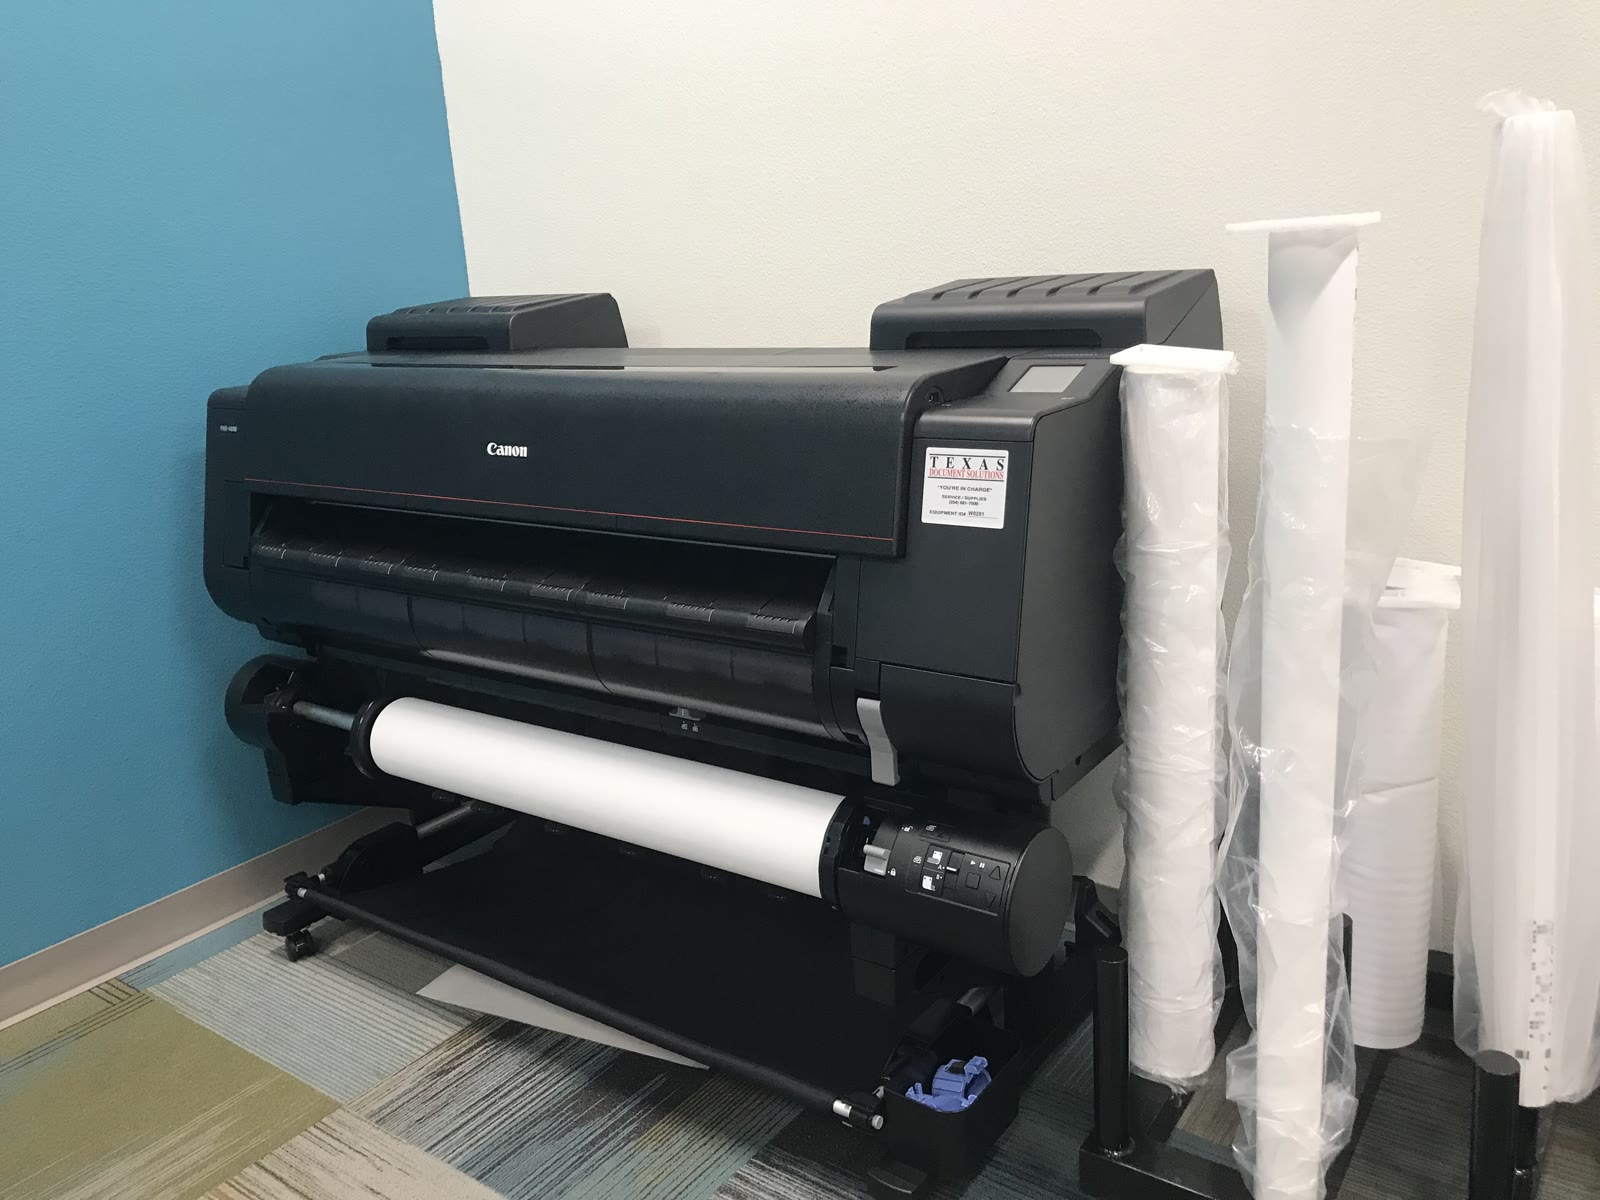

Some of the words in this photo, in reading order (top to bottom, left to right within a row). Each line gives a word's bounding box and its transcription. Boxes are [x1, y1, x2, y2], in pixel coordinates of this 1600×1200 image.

[486, 442, 528, 458] Canon
[930, 456, 1004, 471] TEXAS
[929, 468, 966, 478] DOCUMENT
[966, 469, 1004, 480] SOLUTIONS
